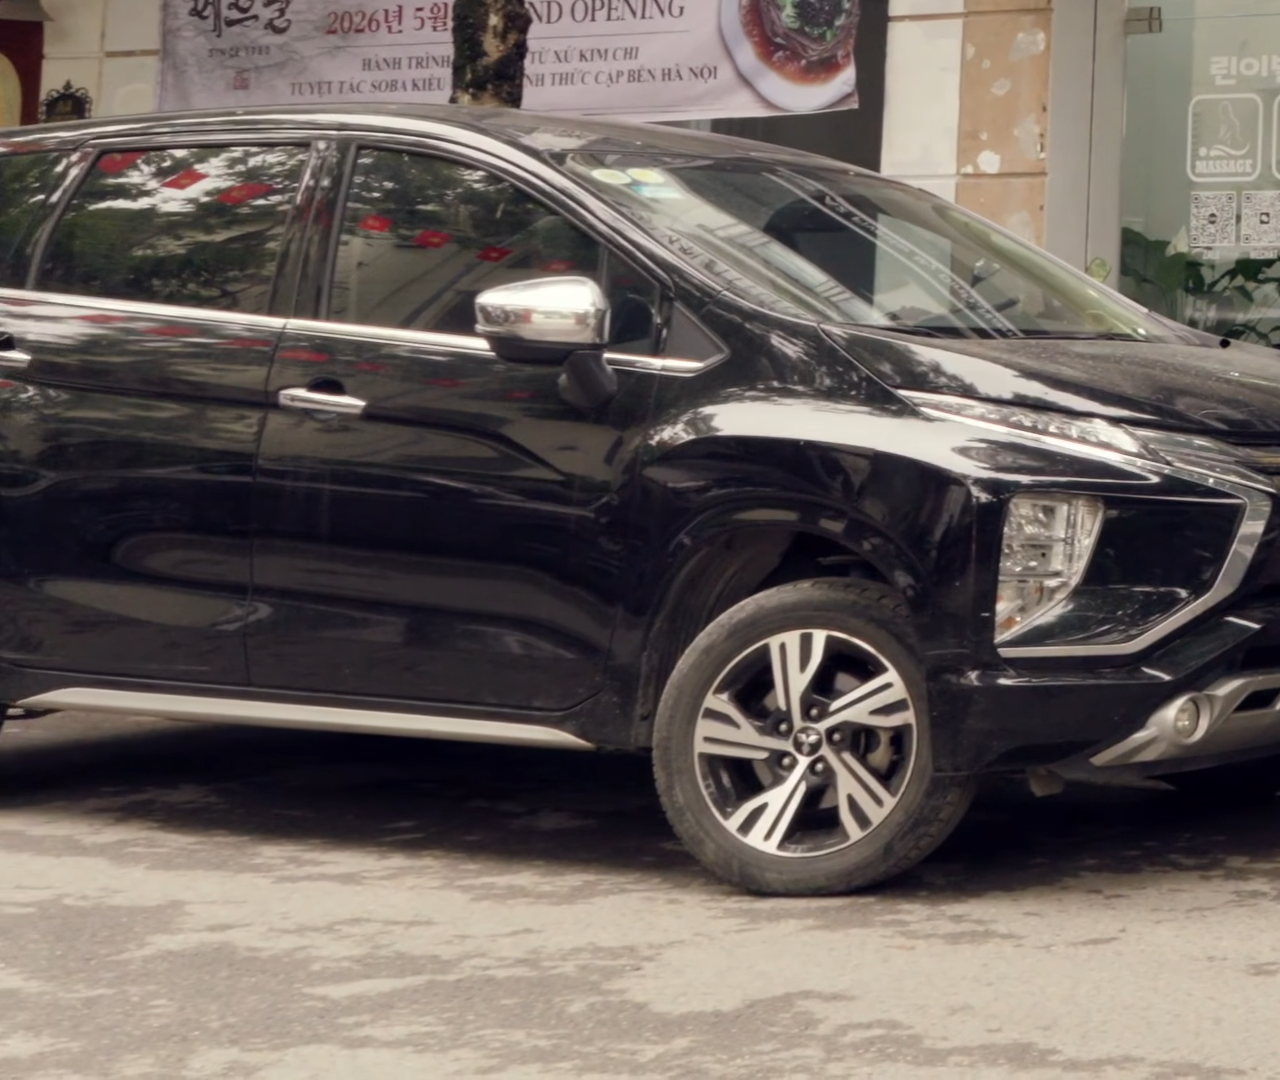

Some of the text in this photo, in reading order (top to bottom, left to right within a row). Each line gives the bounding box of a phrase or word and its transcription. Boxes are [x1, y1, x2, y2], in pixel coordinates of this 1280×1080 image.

[325, 2, 450, 36] 2026년 5월
[362, 55, 402, 72] HÀNH
[407, 52, 451, 70] TRÌNH
[579, 47, 611, 63] KIM
[613, 46, 640, 62] CHI
[290, 80, 334, 98] TUYỆT
[337, 79, 368, 94] TÁC
[371, 77, 408, 93] SOBA
[661, 66, 684, 82] HÀ
[688, 66, 719, 84] NỘI
[1195, 159, 1254, 174] MASSAGE
